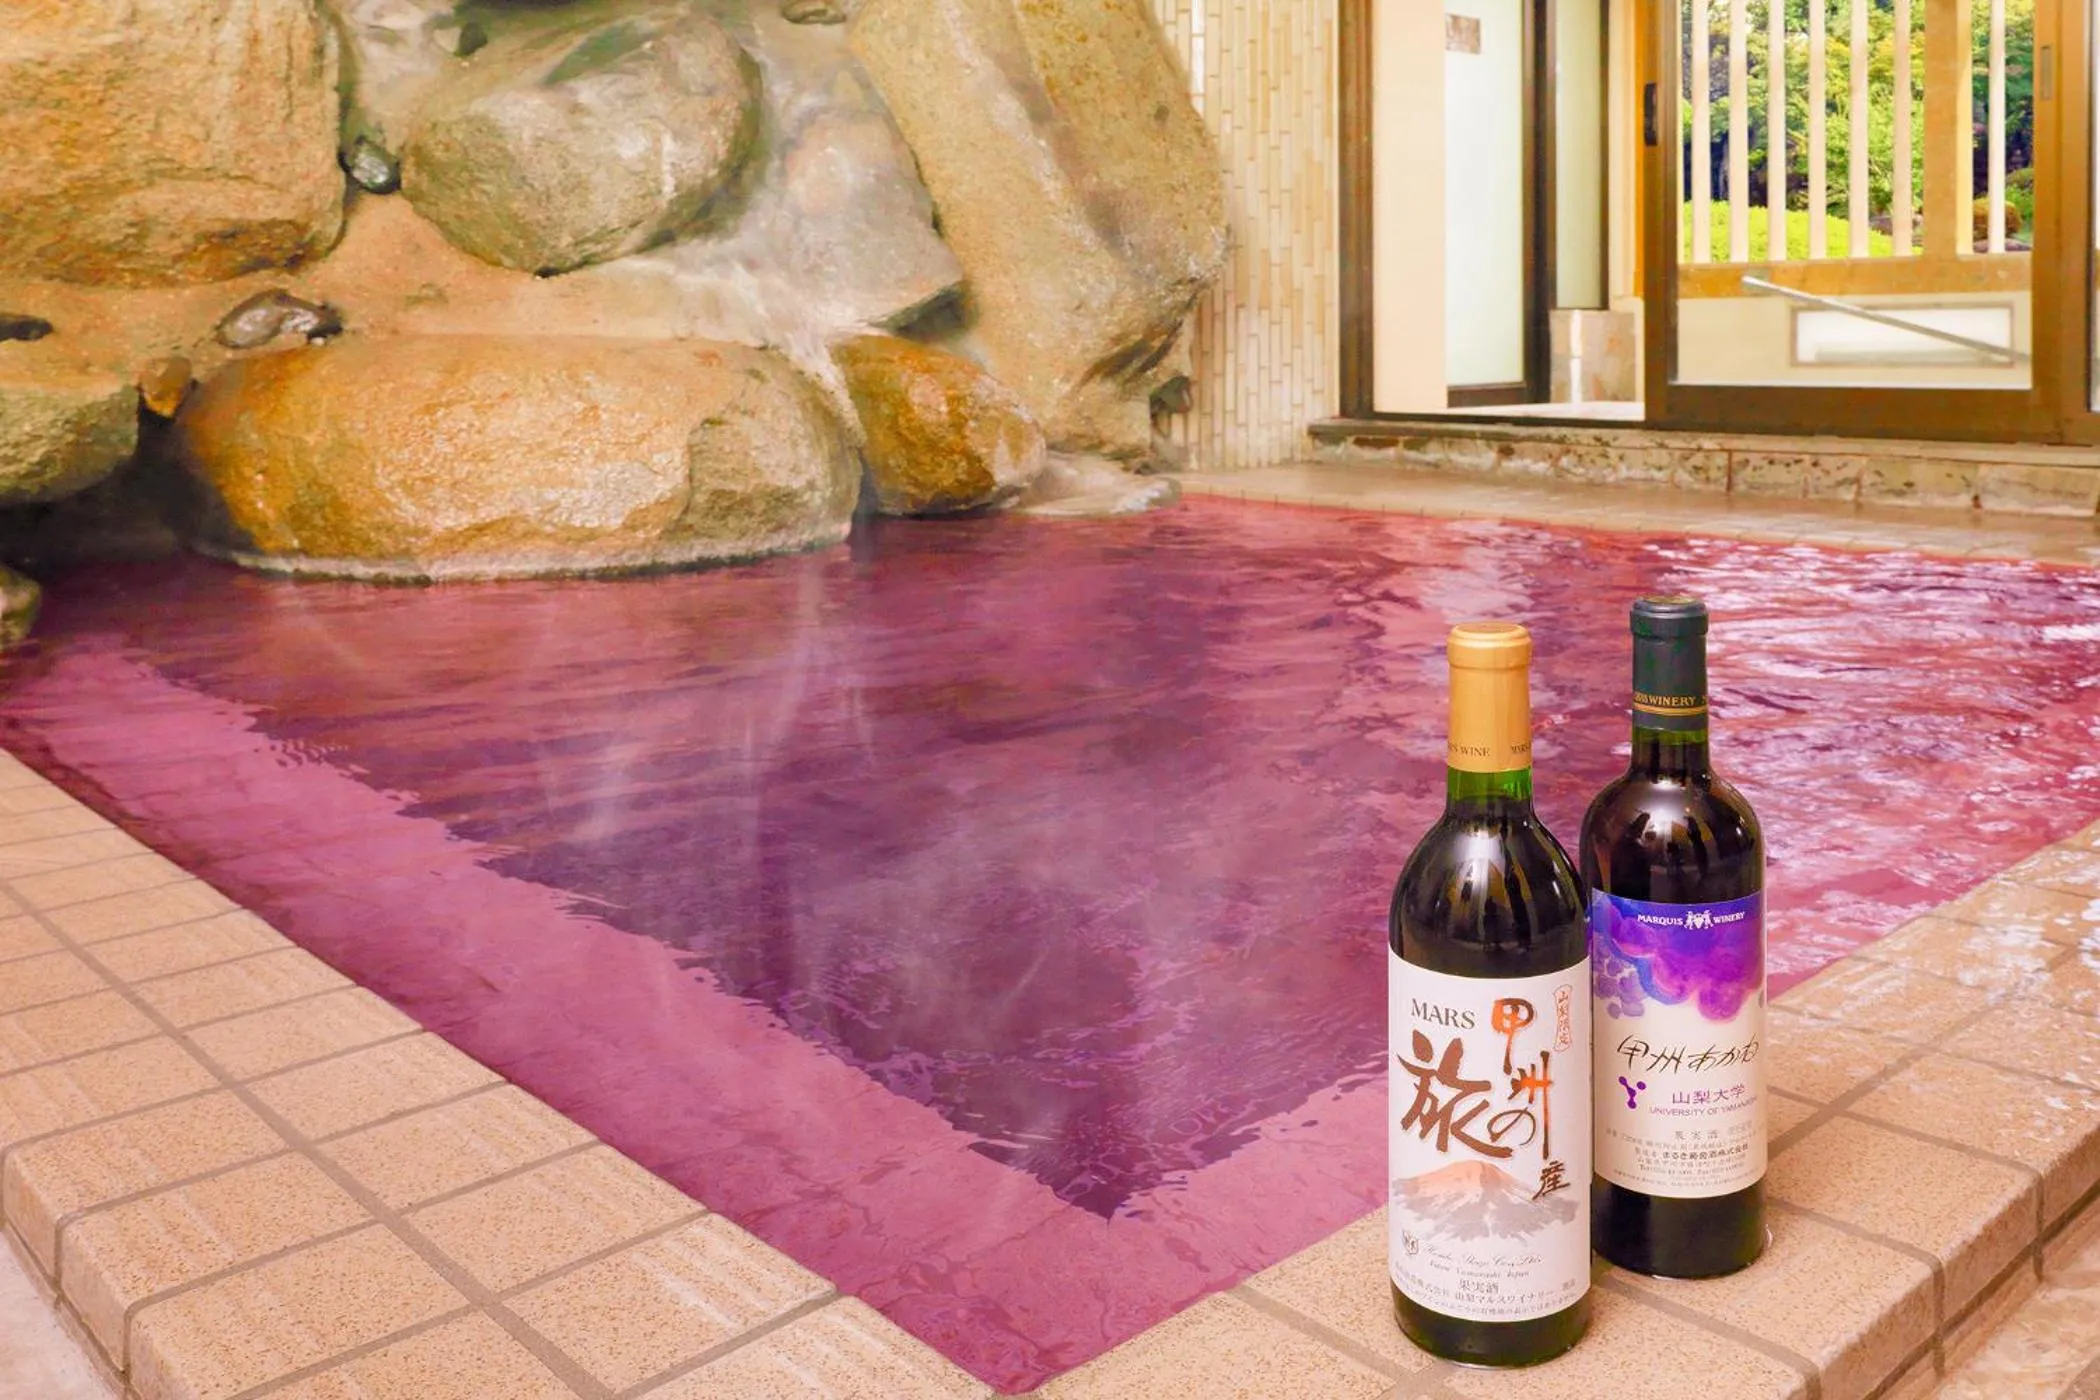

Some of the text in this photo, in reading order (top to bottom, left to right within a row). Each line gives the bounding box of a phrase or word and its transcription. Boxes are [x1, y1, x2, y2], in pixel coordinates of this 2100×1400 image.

[1649, 695, 1697, 706] WINERY
[1460, 746, 1490, 757] WINE
[1637, 911, 1745, 926] MARQUIS WINERY
[1411, 998, 1475, 1030] MARS
[1672, 1083, 1745, 1105] 山梨大学
[1650, 1106, 1705, 1117] UNIVERSITY
[1706, 1106, 1719, 1116] OF
[1459, 1279, 1499, 1294] 果実酒
